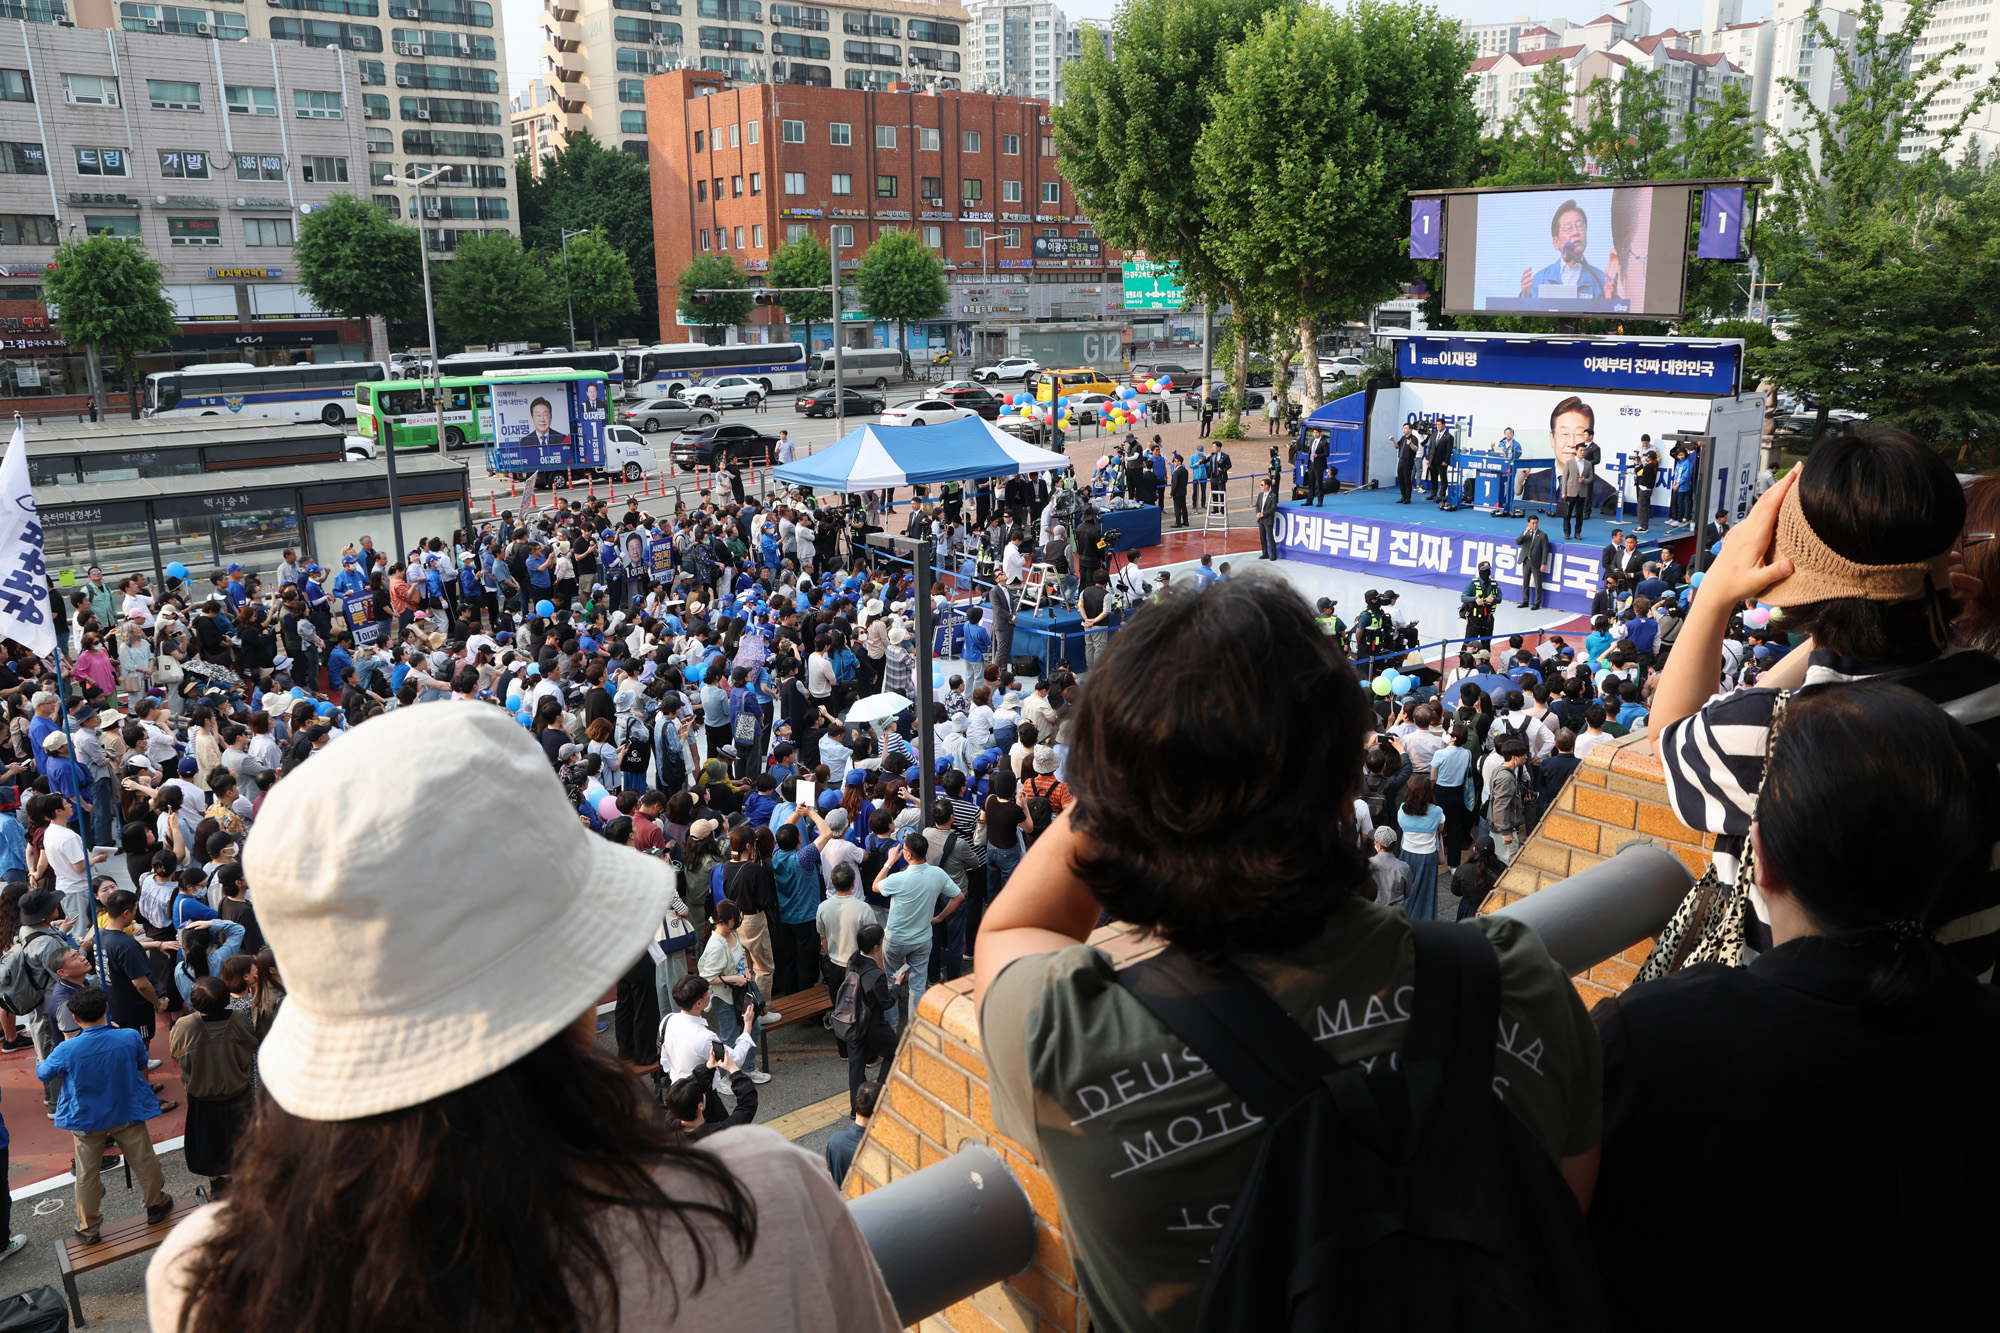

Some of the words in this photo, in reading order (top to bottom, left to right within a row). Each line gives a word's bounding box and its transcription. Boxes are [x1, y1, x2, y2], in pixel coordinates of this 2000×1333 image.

[24, 150, 43, 159] THE
[79, 150, 120, 167] 드림
[163, 153, 203, 170] 가발
[242, 156, 256, 170] 585
[262, 157, 281, 170] 4030
[1423, 215, 1430, 234] 1
[1718, 212, 1727, 234] 1
[1047, 242, 1068, 252] 이광수
[1069, 242, 1089, 252] 신경과
[1089, 244, 1099, 252] 의원
[1083, 331, 1121, 364] G12
[1409, 342, 1417, 365] 1
[1421, 357, 1439, 366] 지금은
[1439, 351, 1478, 367] 이재명
[1583, 356, 1633, 374] 이제부터
[1634, 358, 1661, 375] 진짜
[1661, 359, 1715, 377] 대한민국
[508, 398, 529, 406] 대한민국
[581, 402, 587, 412] 1
[499, 412, 505, 425] 1
[583, 411, 606, 420] 이재명
[1620, 407, 1642, 417] 민주당
[501, 424, 530, 436] 이재명
[590, 421, 598, 438] 1
[538, 447, 544, 457] 1
[592, 441, 600, 462] 이재명
[1484, 480, 1491, 498] 1
[1718, 467, 1729, 511] 1
[203, 495, 249, 508] 택시승차
[40, 508, 102, 522] 속터미널경부선
[652, 542, 671, 552] 사전투표
[1273, 511, 1382, 562] 이제부터
[1388, 529, 1453, 574] 진짜
[1073, 1046, 1211, 1118] DEUS
